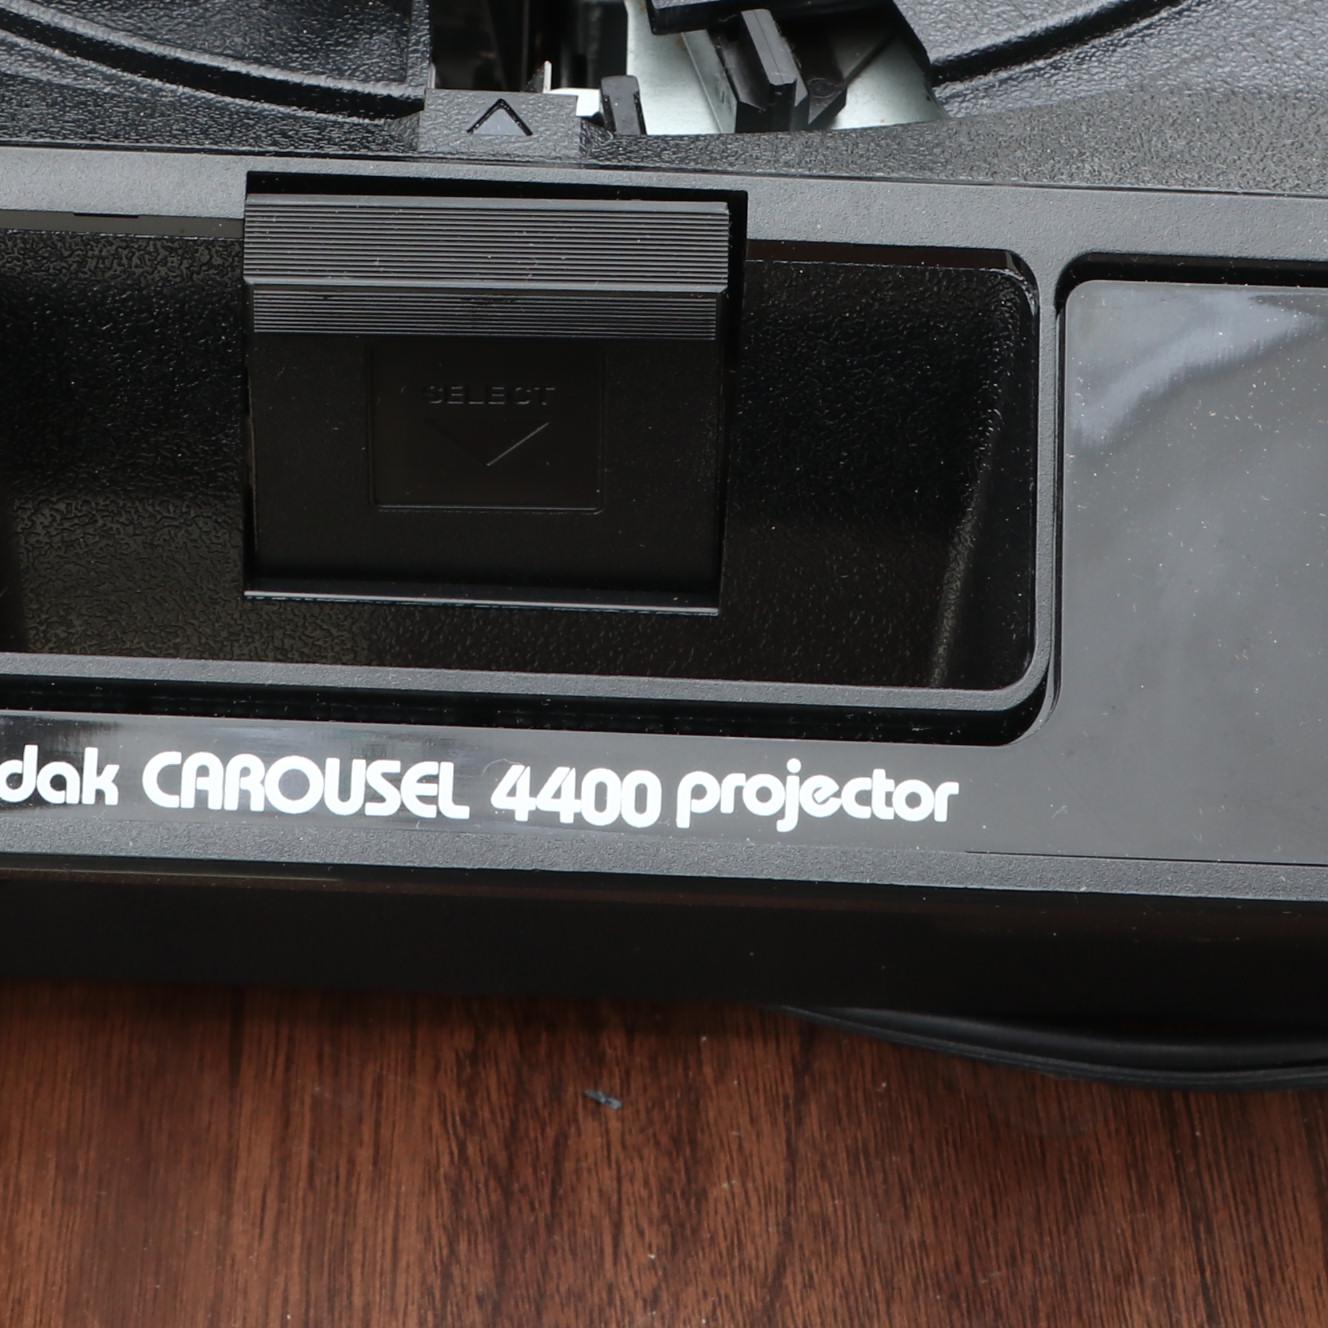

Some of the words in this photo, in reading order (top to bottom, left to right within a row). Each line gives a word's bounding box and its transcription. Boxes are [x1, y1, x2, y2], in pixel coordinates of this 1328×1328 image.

[427, 384, 557, 406] SELECT
[140, 749, 472, 820] CAROUSEL
[489, 763, 664, 830] 4400
[674, 757, 961, 834] projector
